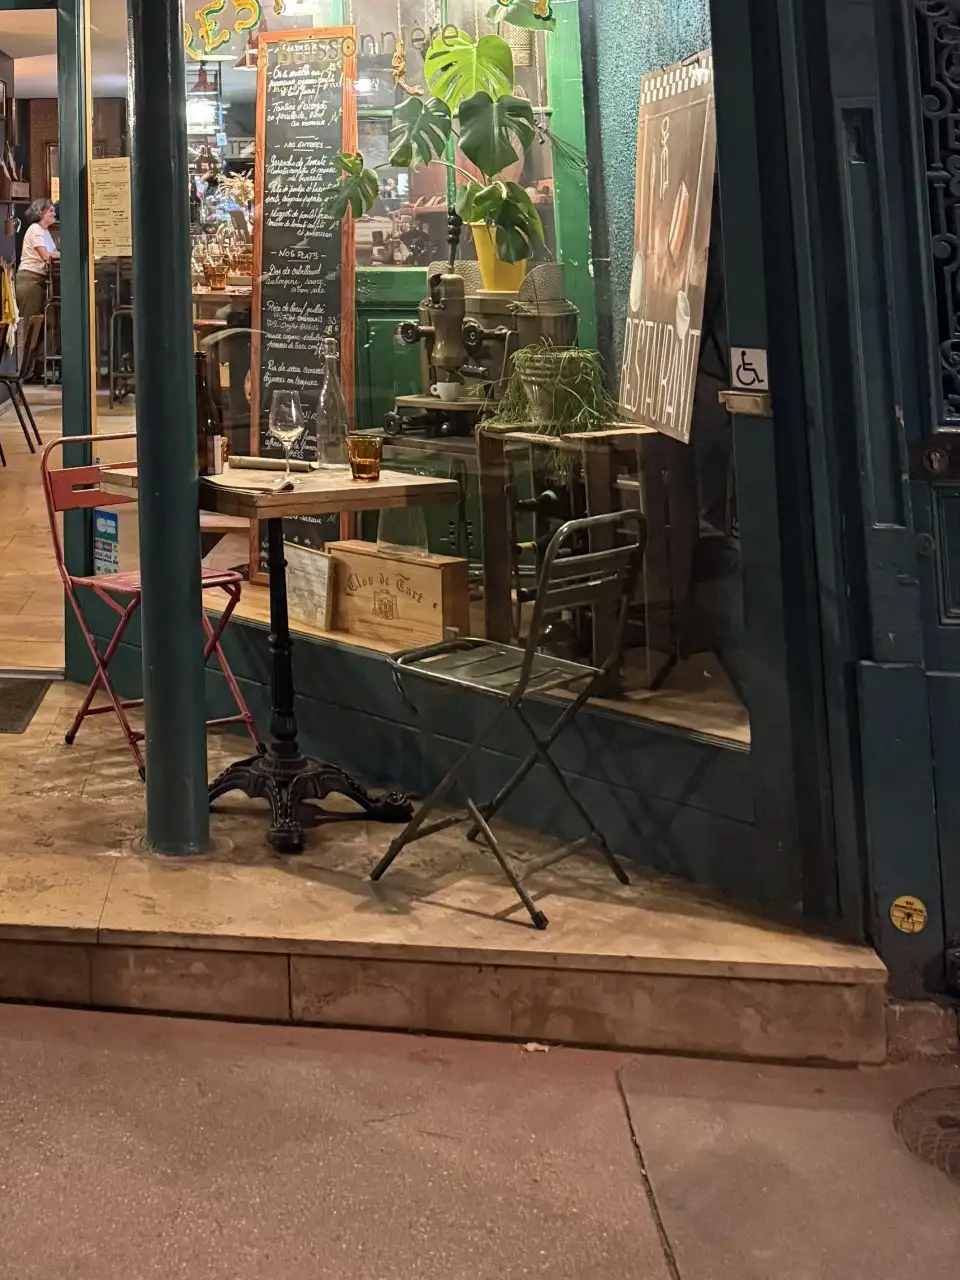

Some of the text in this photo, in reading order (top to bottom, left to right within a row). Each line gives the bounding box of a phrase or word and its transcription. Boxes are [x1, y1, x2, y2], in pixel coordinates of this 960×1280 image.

[279, 248, 318, 259] NOS PLATS
[347, 572, 424, 603] Clos de Tart
